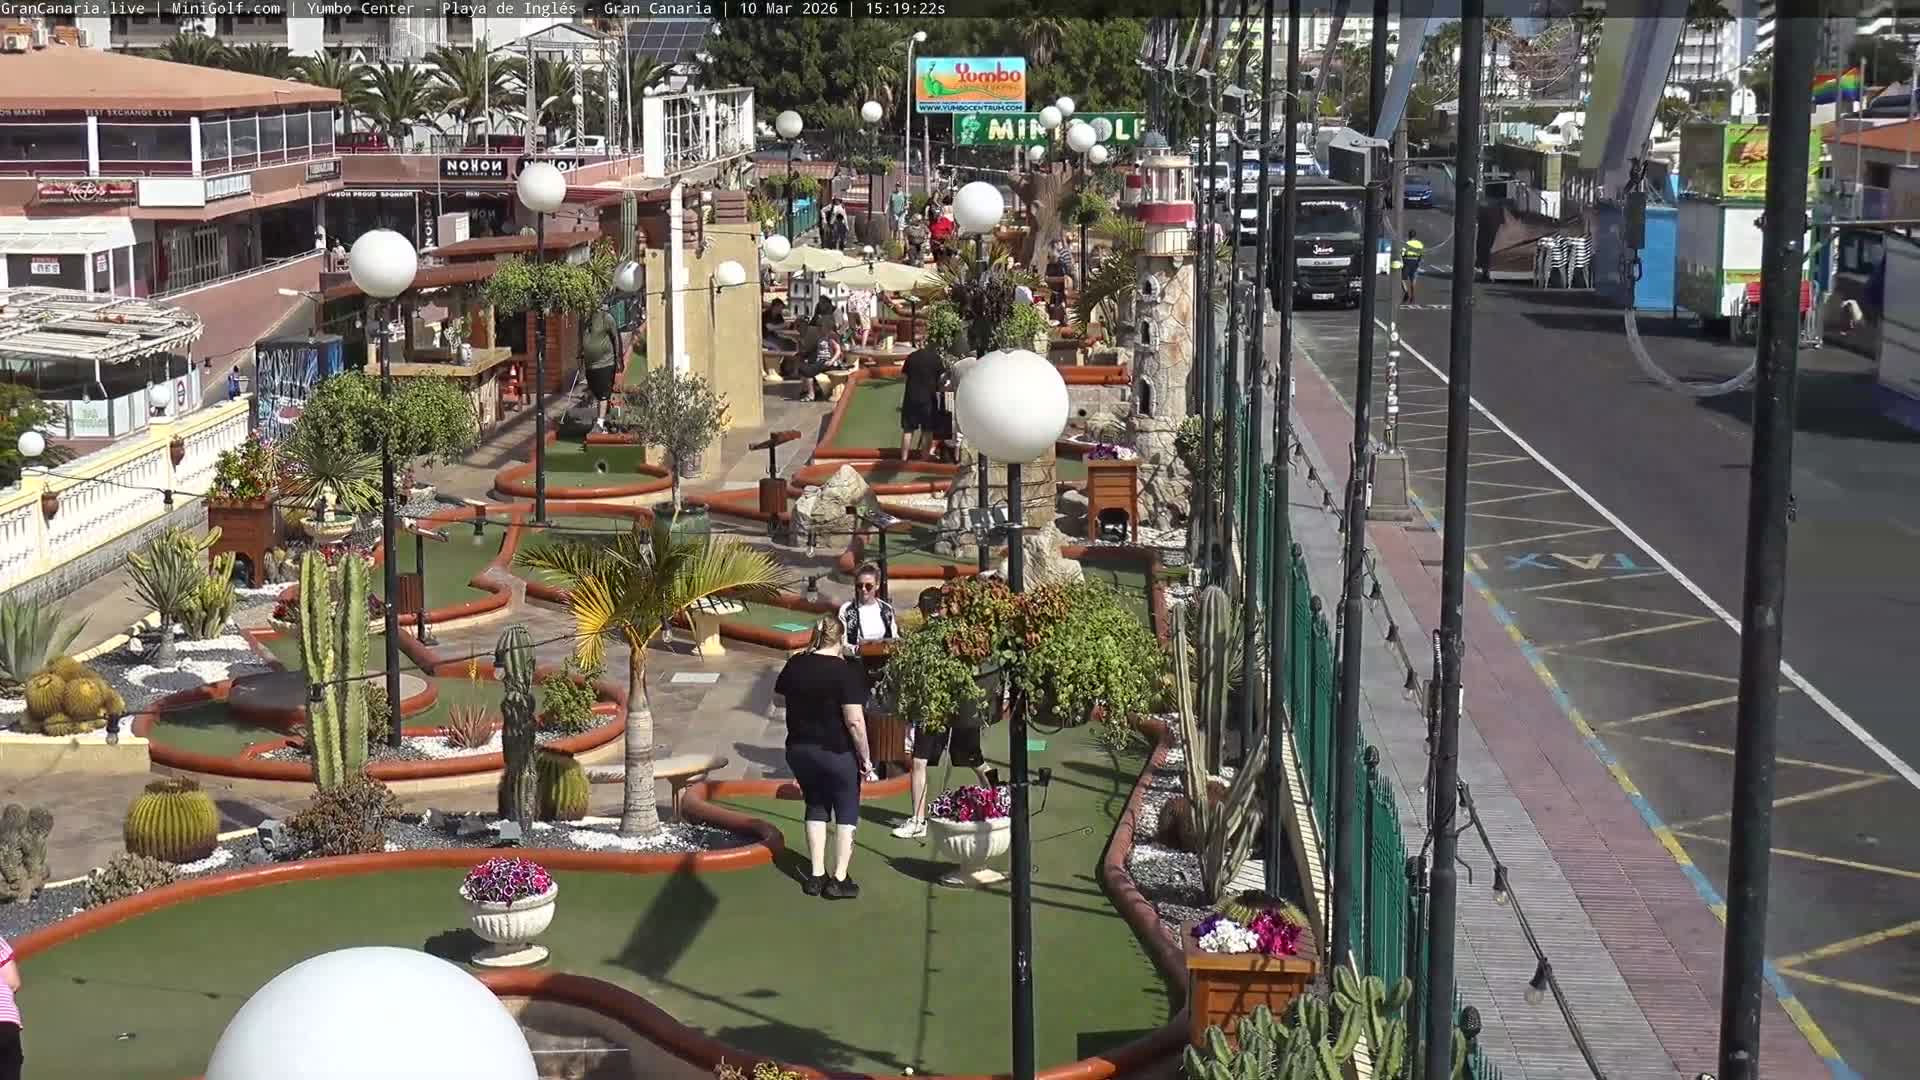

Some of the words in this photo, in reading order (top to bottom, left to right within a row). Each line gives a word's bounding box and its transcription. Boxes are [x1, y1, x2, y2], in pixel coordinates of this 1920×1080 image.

[955, 61, 1021, 82] Yumbo
[919, 104, 1023, 112] WWW.YUMBOCENTRUM.COM
[1470, 552, 1662, 570] TAXI
